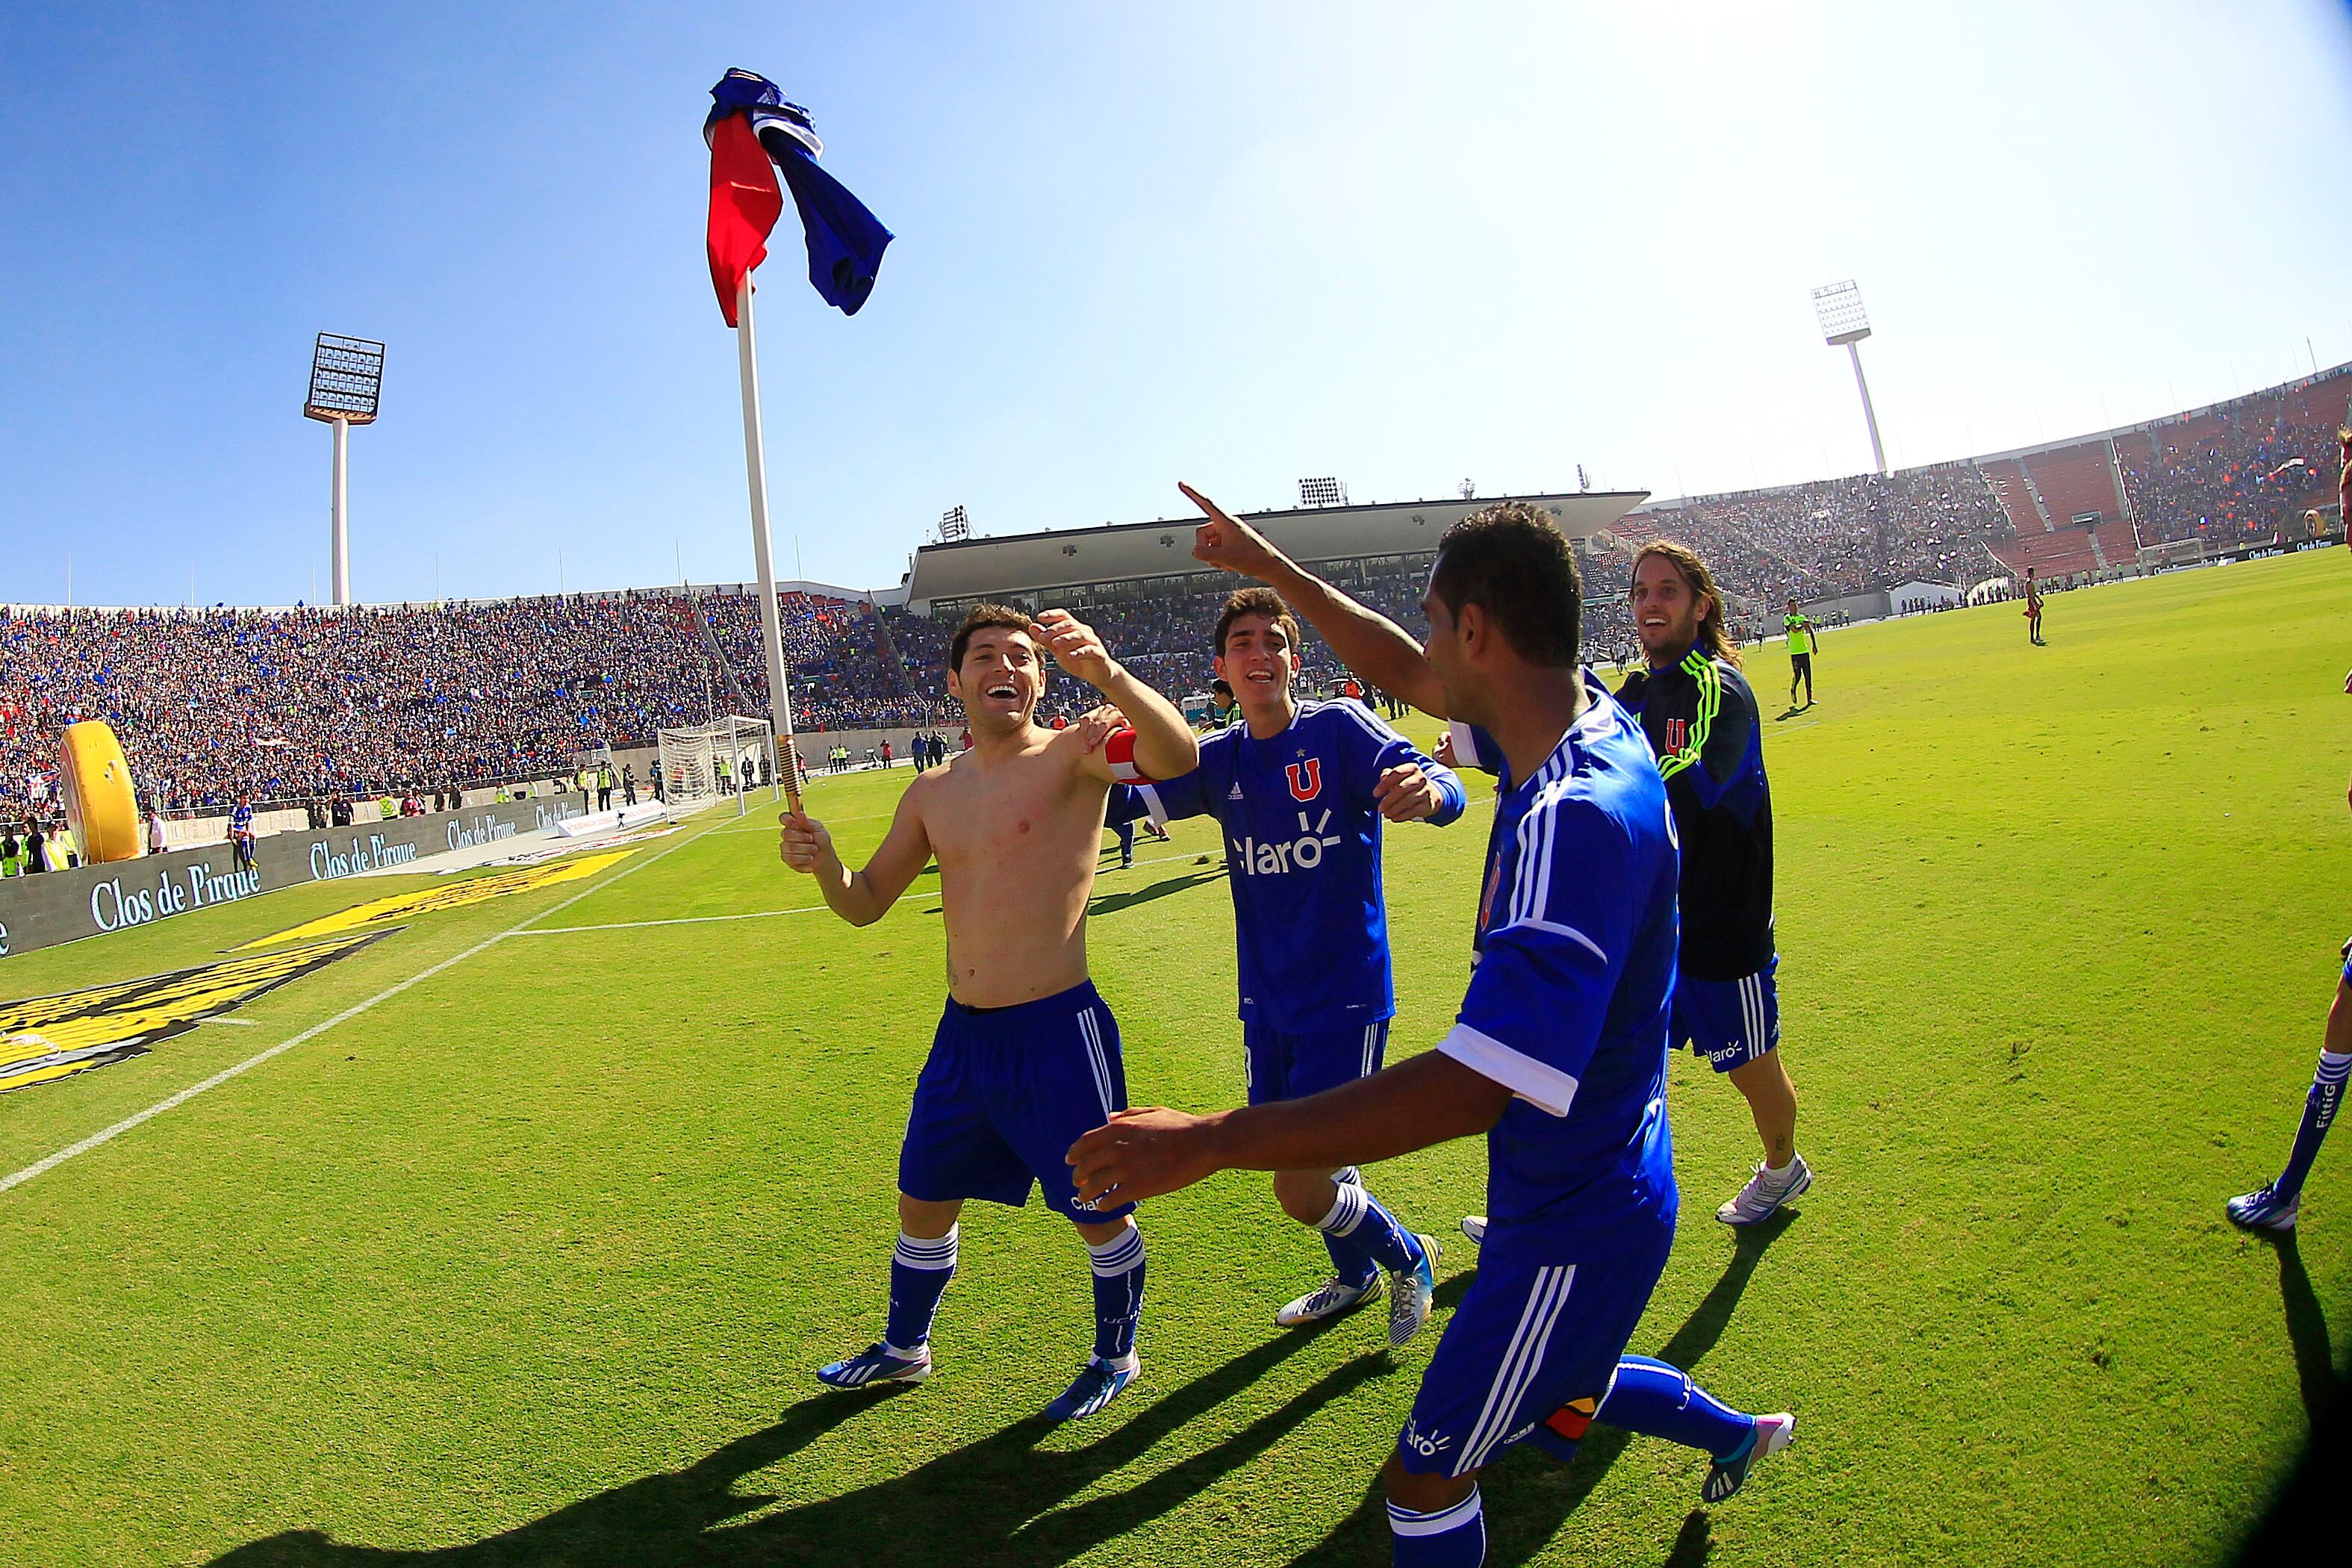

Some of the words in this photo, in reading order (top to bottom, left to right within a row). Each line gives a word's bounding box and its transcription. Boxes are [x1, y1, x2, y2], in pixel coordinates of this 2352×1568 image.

[1666, 718, 1685, 756] U
[1285, 757, 1322, 803] U
[447, 819, 473, 850] Clos
[474, 816, 486, 845] de
[310, 839, 351, 880] Clos
[352, 837, 370, 871] de
[370, 833, 417, 870] Pirque
[90, 877, 154, 931] Clos
[157, 870, 187, 915] de
[187, 862, 261, 907] Pirque
